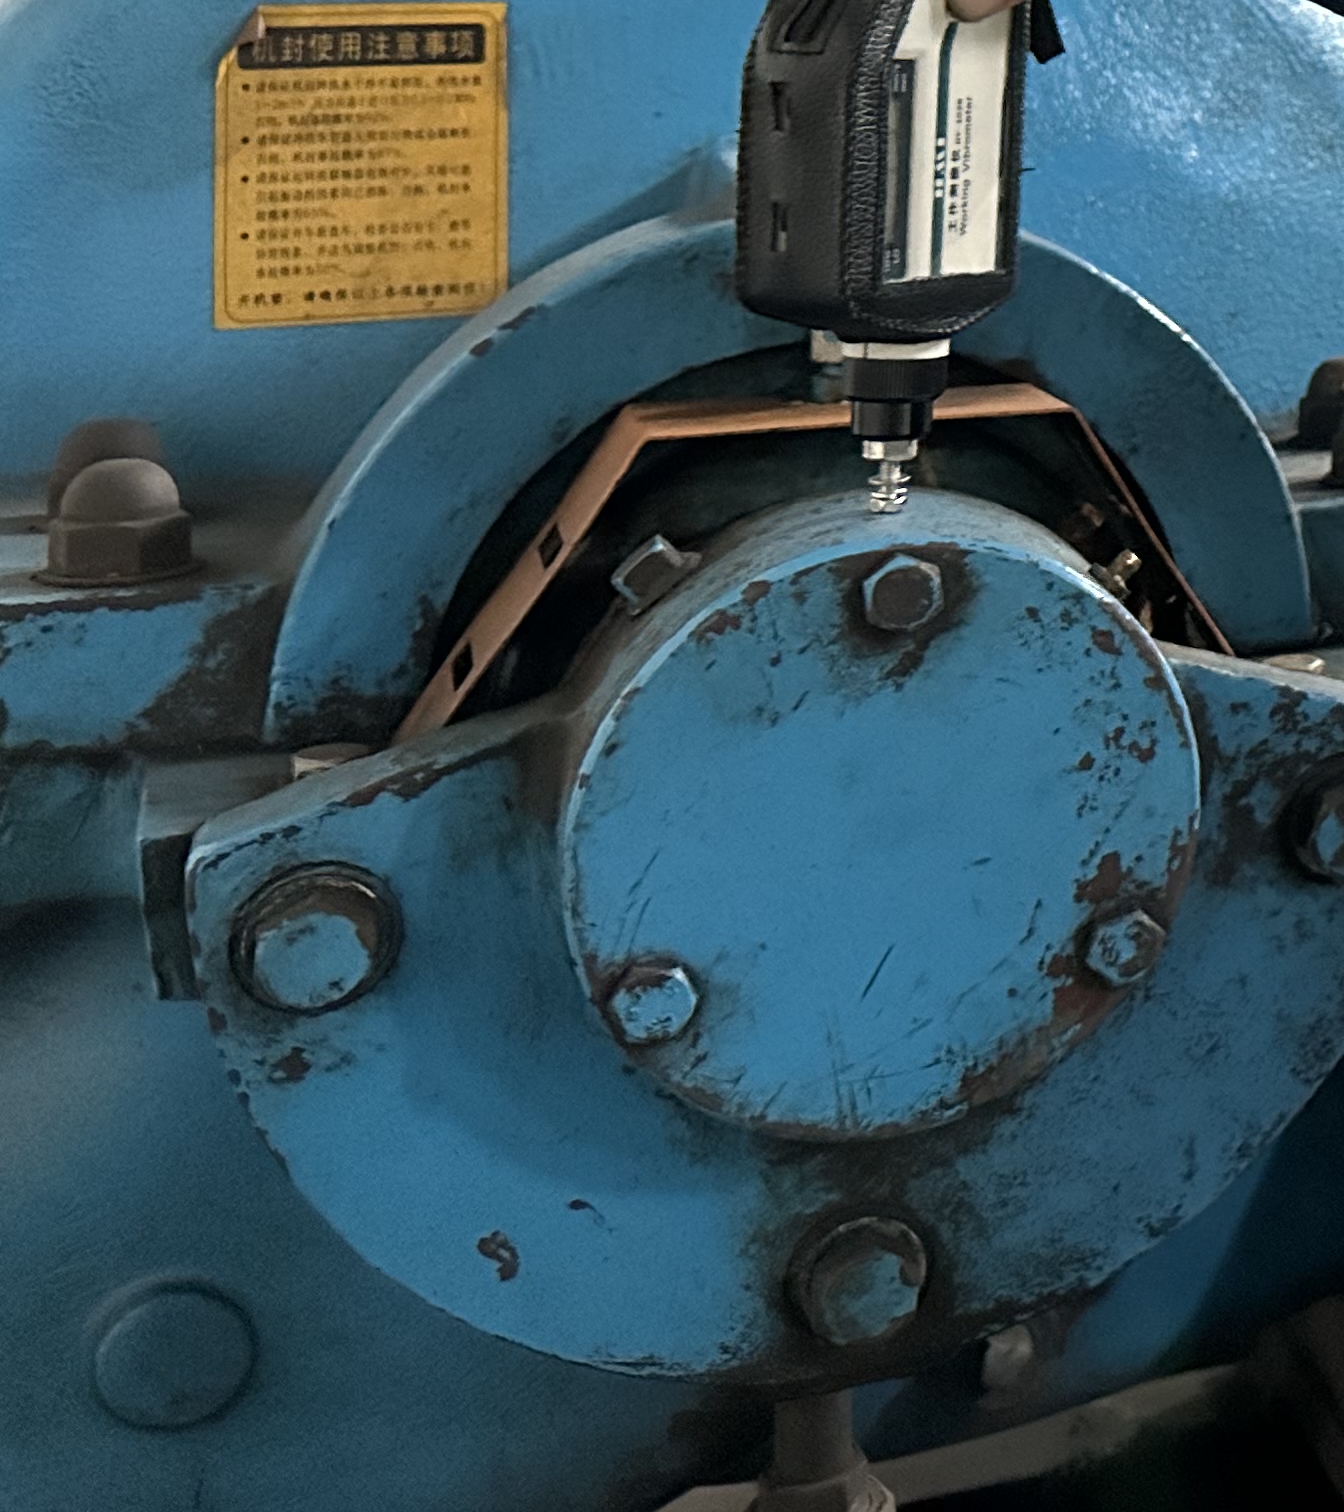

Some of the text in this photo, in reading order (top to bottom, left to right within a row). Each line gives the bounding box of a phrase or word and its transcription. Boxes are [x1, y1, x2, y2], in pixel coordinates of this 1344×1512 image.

[251, 31, 476, 63] 机封使用注意事项
